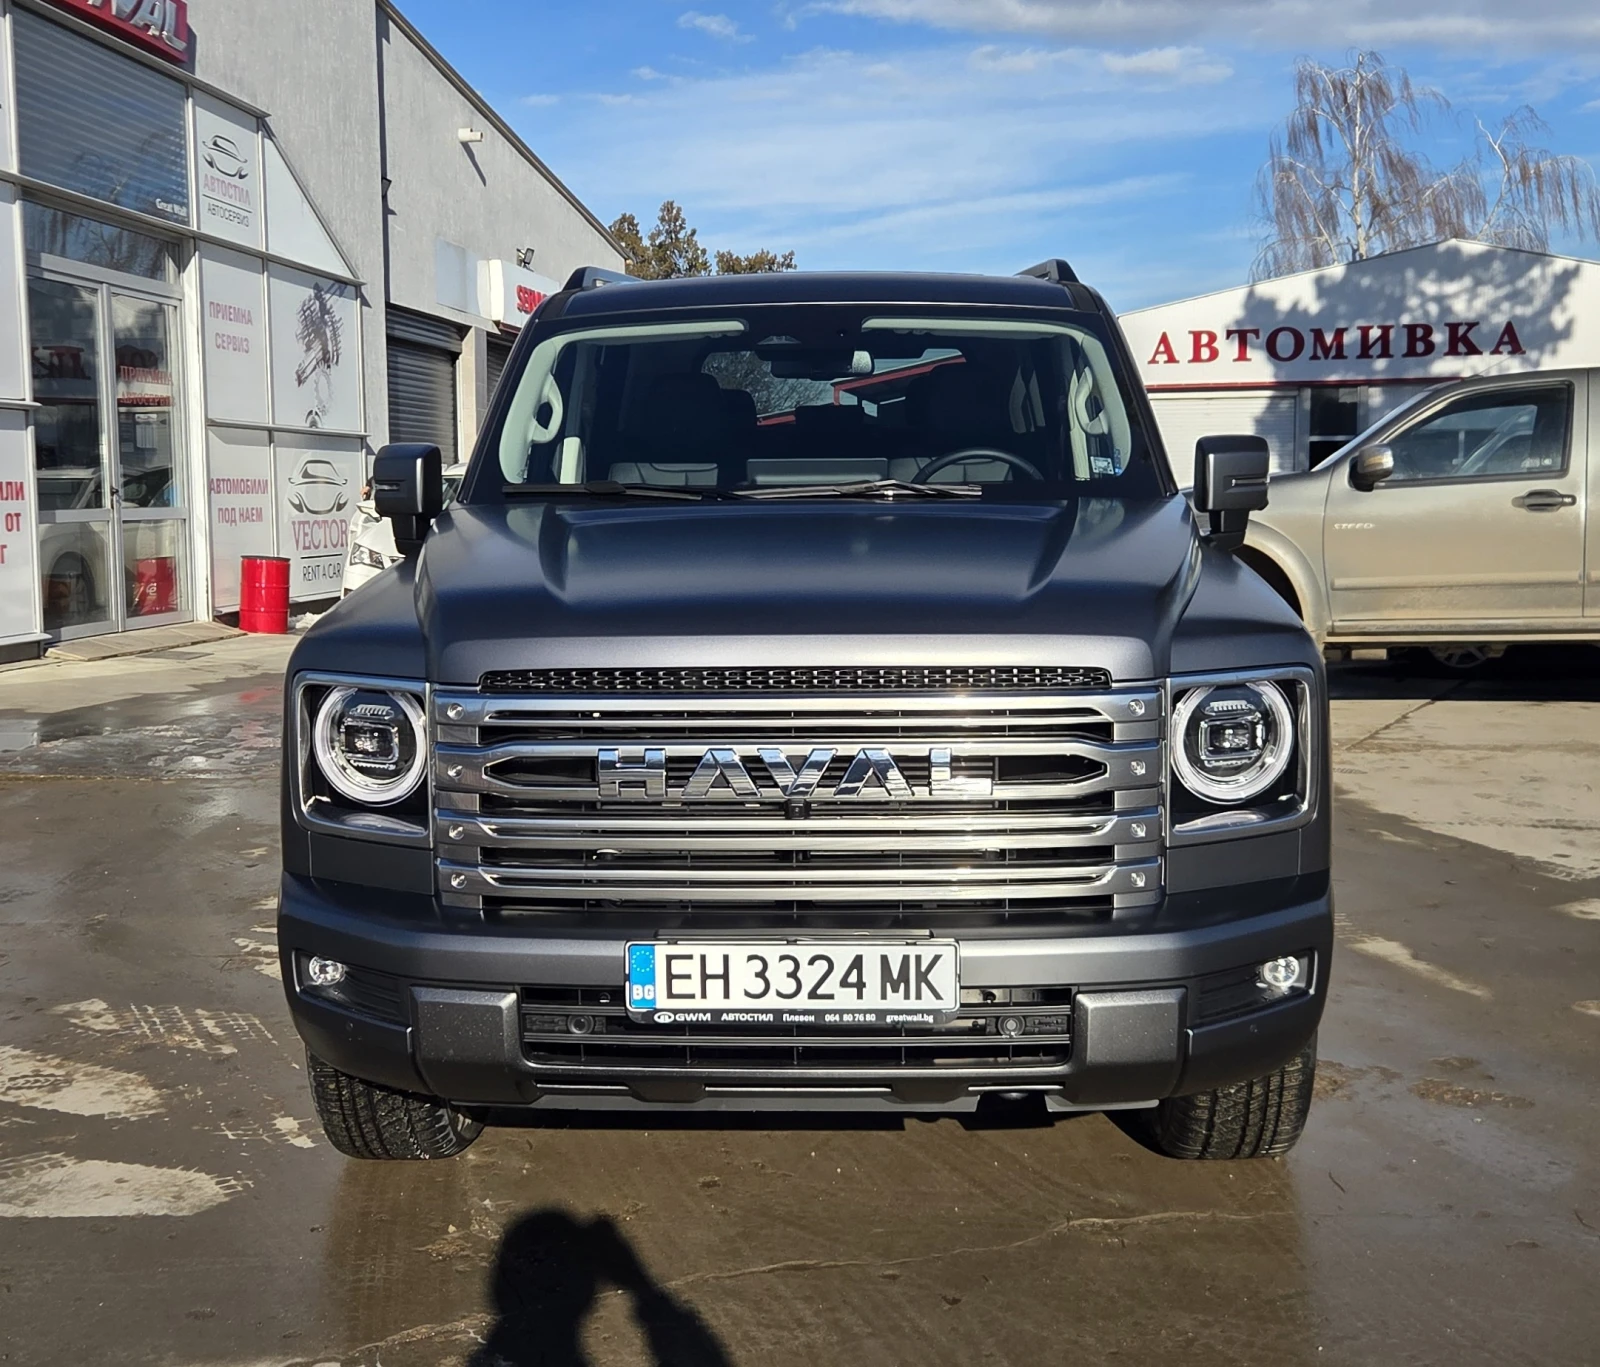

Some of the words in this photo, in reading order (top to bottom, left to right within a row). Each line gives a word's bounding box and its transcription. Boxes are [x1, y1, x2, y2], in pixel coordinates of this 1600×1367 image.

[208, 202, 249, 227] АВТОСЕРВИЗ
[209, 300, 253, 326] ПРИЕМНА
[215, 332, 250, 354] СЕРВИЗ
[1147, 320, 1527, 365] АВТОМИВКА
[209, 478, 269, 495] АВТОМОБИЛИ
[5, 512, 22, 532] ОТ
[217, 507, 237, 527] ПОД
[239, 507, 263, 523] НАЕМ
[292, 519, 348, 551] VECTOR
[302, 563, 321, 581] RENT
[322, 562, 328, 579] A
[328, 561, 343, 579] CAR
[597, 748, 994, 798] HAVAL
[665, 954, 730, 1000] EH
[743, 953, 867, 1000] 3324
[880, 954, 944, 1000] MK
[632, 984, 655, 1000] BG
[675, 1012, 711, 1022] GWM
[721, 1012, 773, 1022] АВТОСТИЛ
[782, 1013, 815, 1023] Плевен
[824, 1012, 840, 1023] 064
[842, 1012, 853, 1023] 80
[854, 1012, 865, 1023] 76
[865, 1012, 876, 1023] 80
[885, 1012, 934, 1024] greatwall.bg
